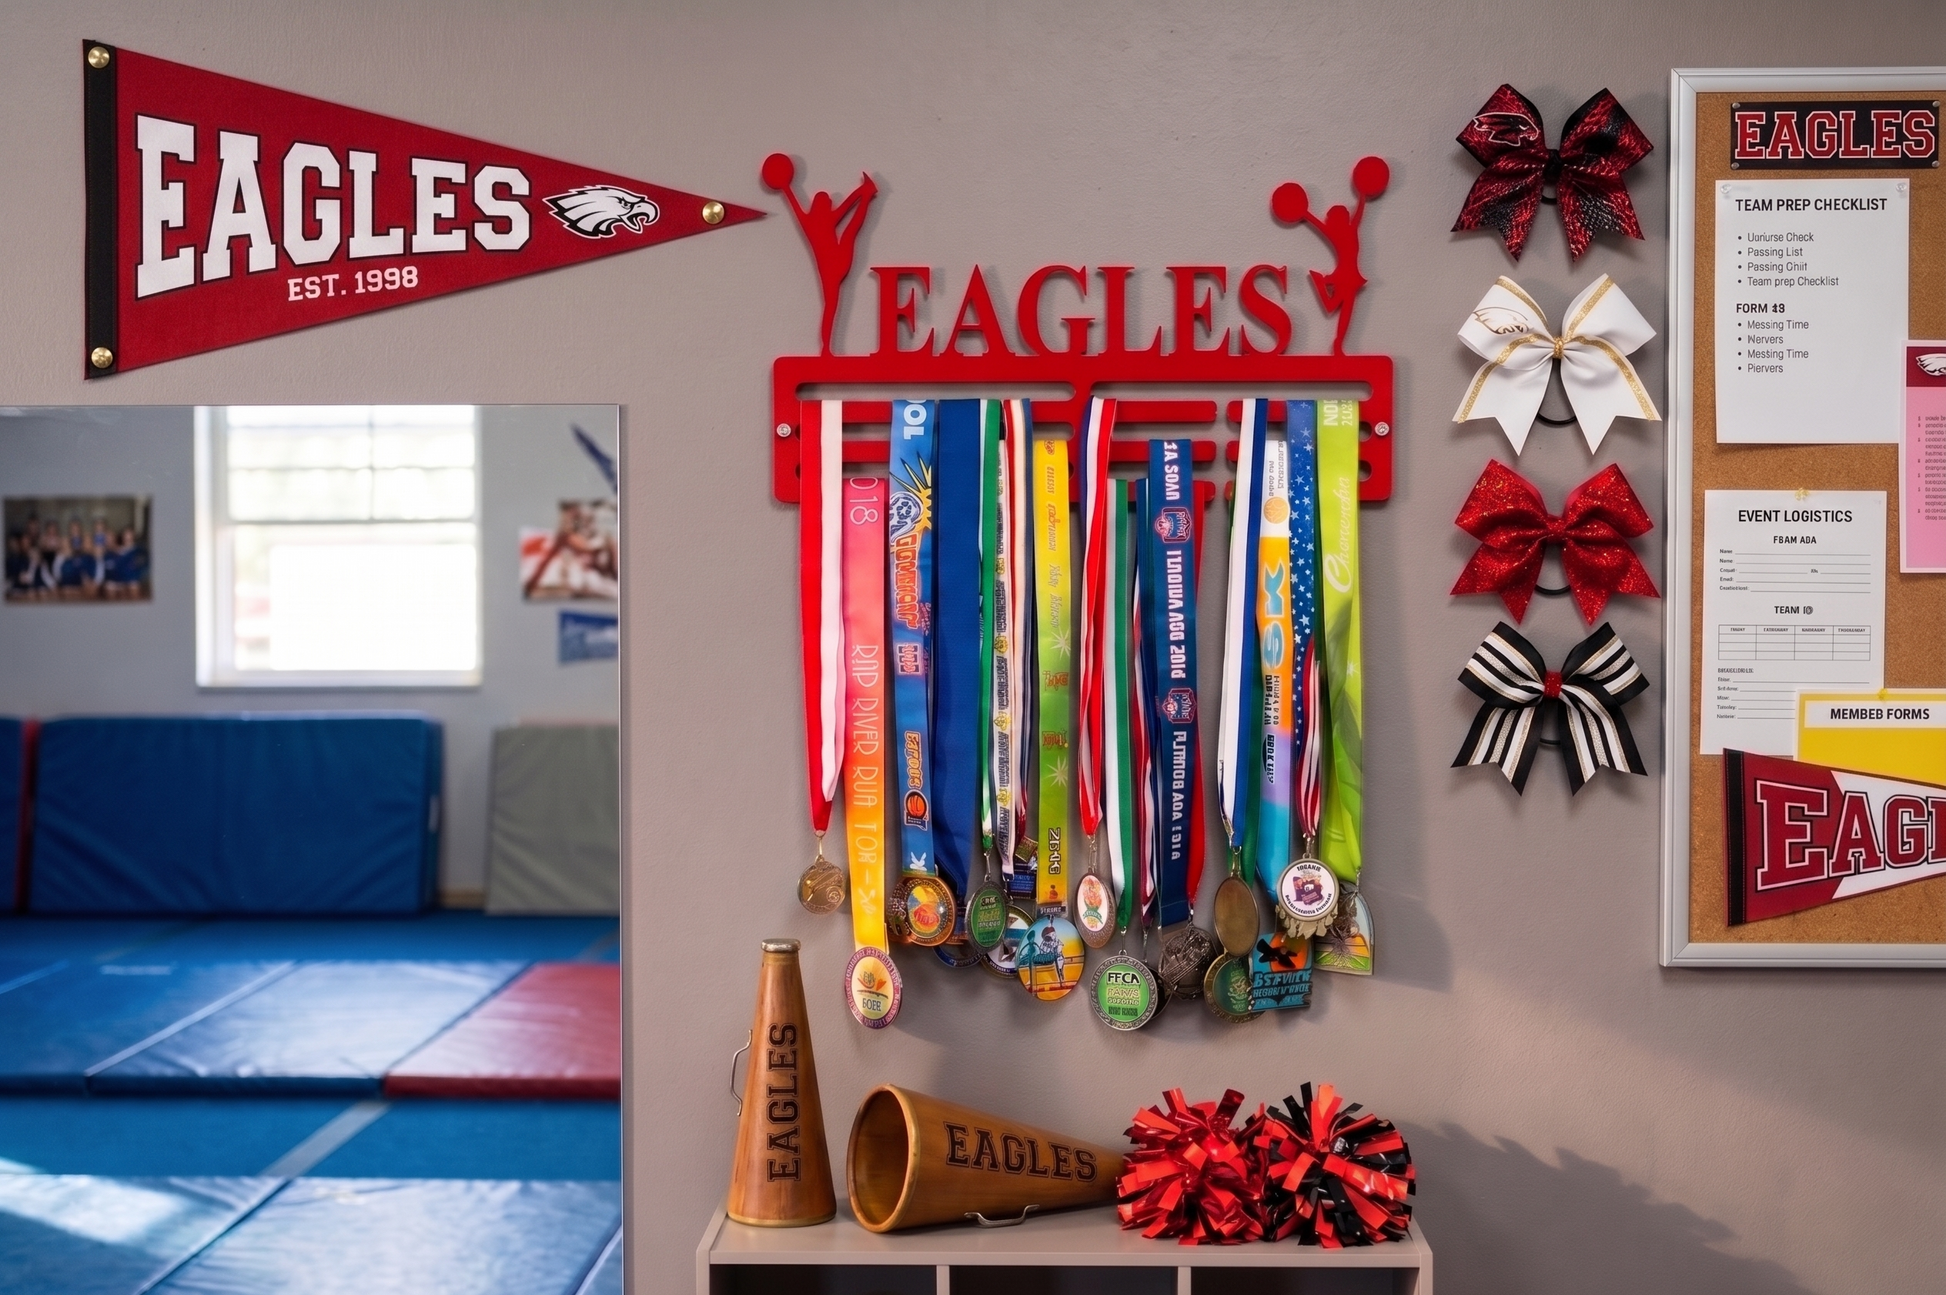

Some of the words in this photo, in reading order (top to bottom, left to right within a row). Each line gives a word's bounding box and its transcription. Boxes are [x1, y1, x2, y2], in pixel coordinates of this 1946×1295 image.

[1734, 109, 1936, 160] EAGLES
[135, 113, 533, 300] EAGLES
[1735, 198, 1773, 212] TEAM
[1776, 198, 1811, 212] PREP
[1813, 198, 1888, 212] CHECKLIST
[1786, 232, 1815, 242] Check
[1747, 247, 1784, 259] Passing
[1786, 247, 1803, 257] List
[1747, 261, 1784, 274] Passing
[287, 273, 347, 302] EST.
[353, 266, 419, 297] 1998
[1747, 276, 1772, 286] Team
[1774, 277, 1796, 288] prep
[1797, 276, 1839, 286] Checklist
[870, 264, 1292, 358] EAGLES
[1736, 303, 1768, 314] FORM
[1747, 320, 1784, 332] Messing
[1786, 320, 1809, 330] Time
[1786, 349, 1809, 359] Time
[903, 400, 927, 440] OL
[1738, 510, 1781, 523] EVENT
[1784, 510, 1854, 523] LOGISTICS
[1886, 708, 1931, 720] FORMS
[767, 1022, 800, 1182] EAGLES
[942, 1122, 1098, 1183] EAGLES
